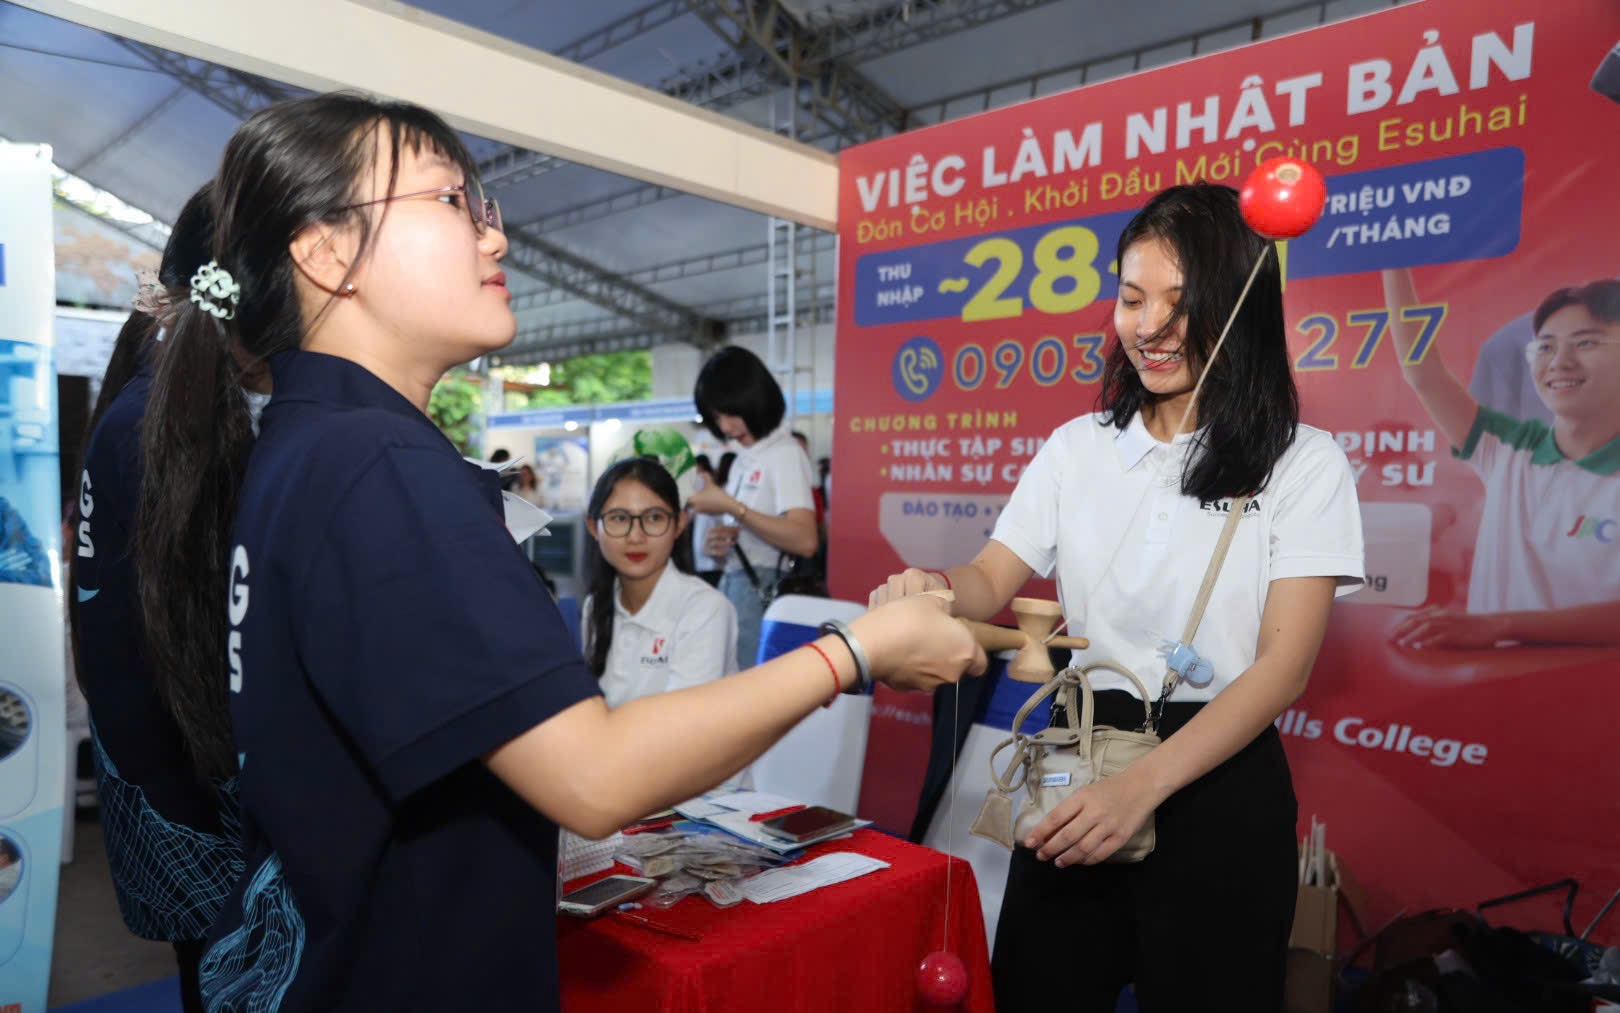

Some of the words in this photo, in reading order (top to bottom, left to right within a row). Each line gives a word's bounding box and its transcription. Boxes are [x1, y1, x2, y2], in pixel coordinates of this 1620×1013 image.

[856, 153, 966, 216] VIỆC
[982, 127, 1103, 188] LÀM
[1125, 72, 1323, 159] NHẬT
[1346, 21, 1535, 116] BẢN
[856, 219, 903, 244] Đón
[911, 208, 946, 234] Cơ
[954, 199, 998, 228] Hội
[1024, 179, 1089, 214] Khởi
[1100, 166, 1161, 200] Đầu
[1175, 149, 1241, 187] Mới
[1377, 94, 1528, 152] Esuhai
[1401, 174, 1472, 203] VNĐ
[1326, 213, 1450, 249] /THÁNG
[877, 261, 912, 282] THU
[877, 283, 924, 309] NHẬP
[952, 332, 1107, 391] 0903
[1294, 302, 1449, 373] 277
[945, 409, 1018, 430] TRÌNH
[890, 437, 952, 460] THỰC
[958, 434, 1002, 461] TẬP
[890, 460, 953, 482] NHÂN
[961, 463, 995, 486] SỰ
[1381, 460, 1438, 487] SƯ
[1332, 716, 1489, 767] College
